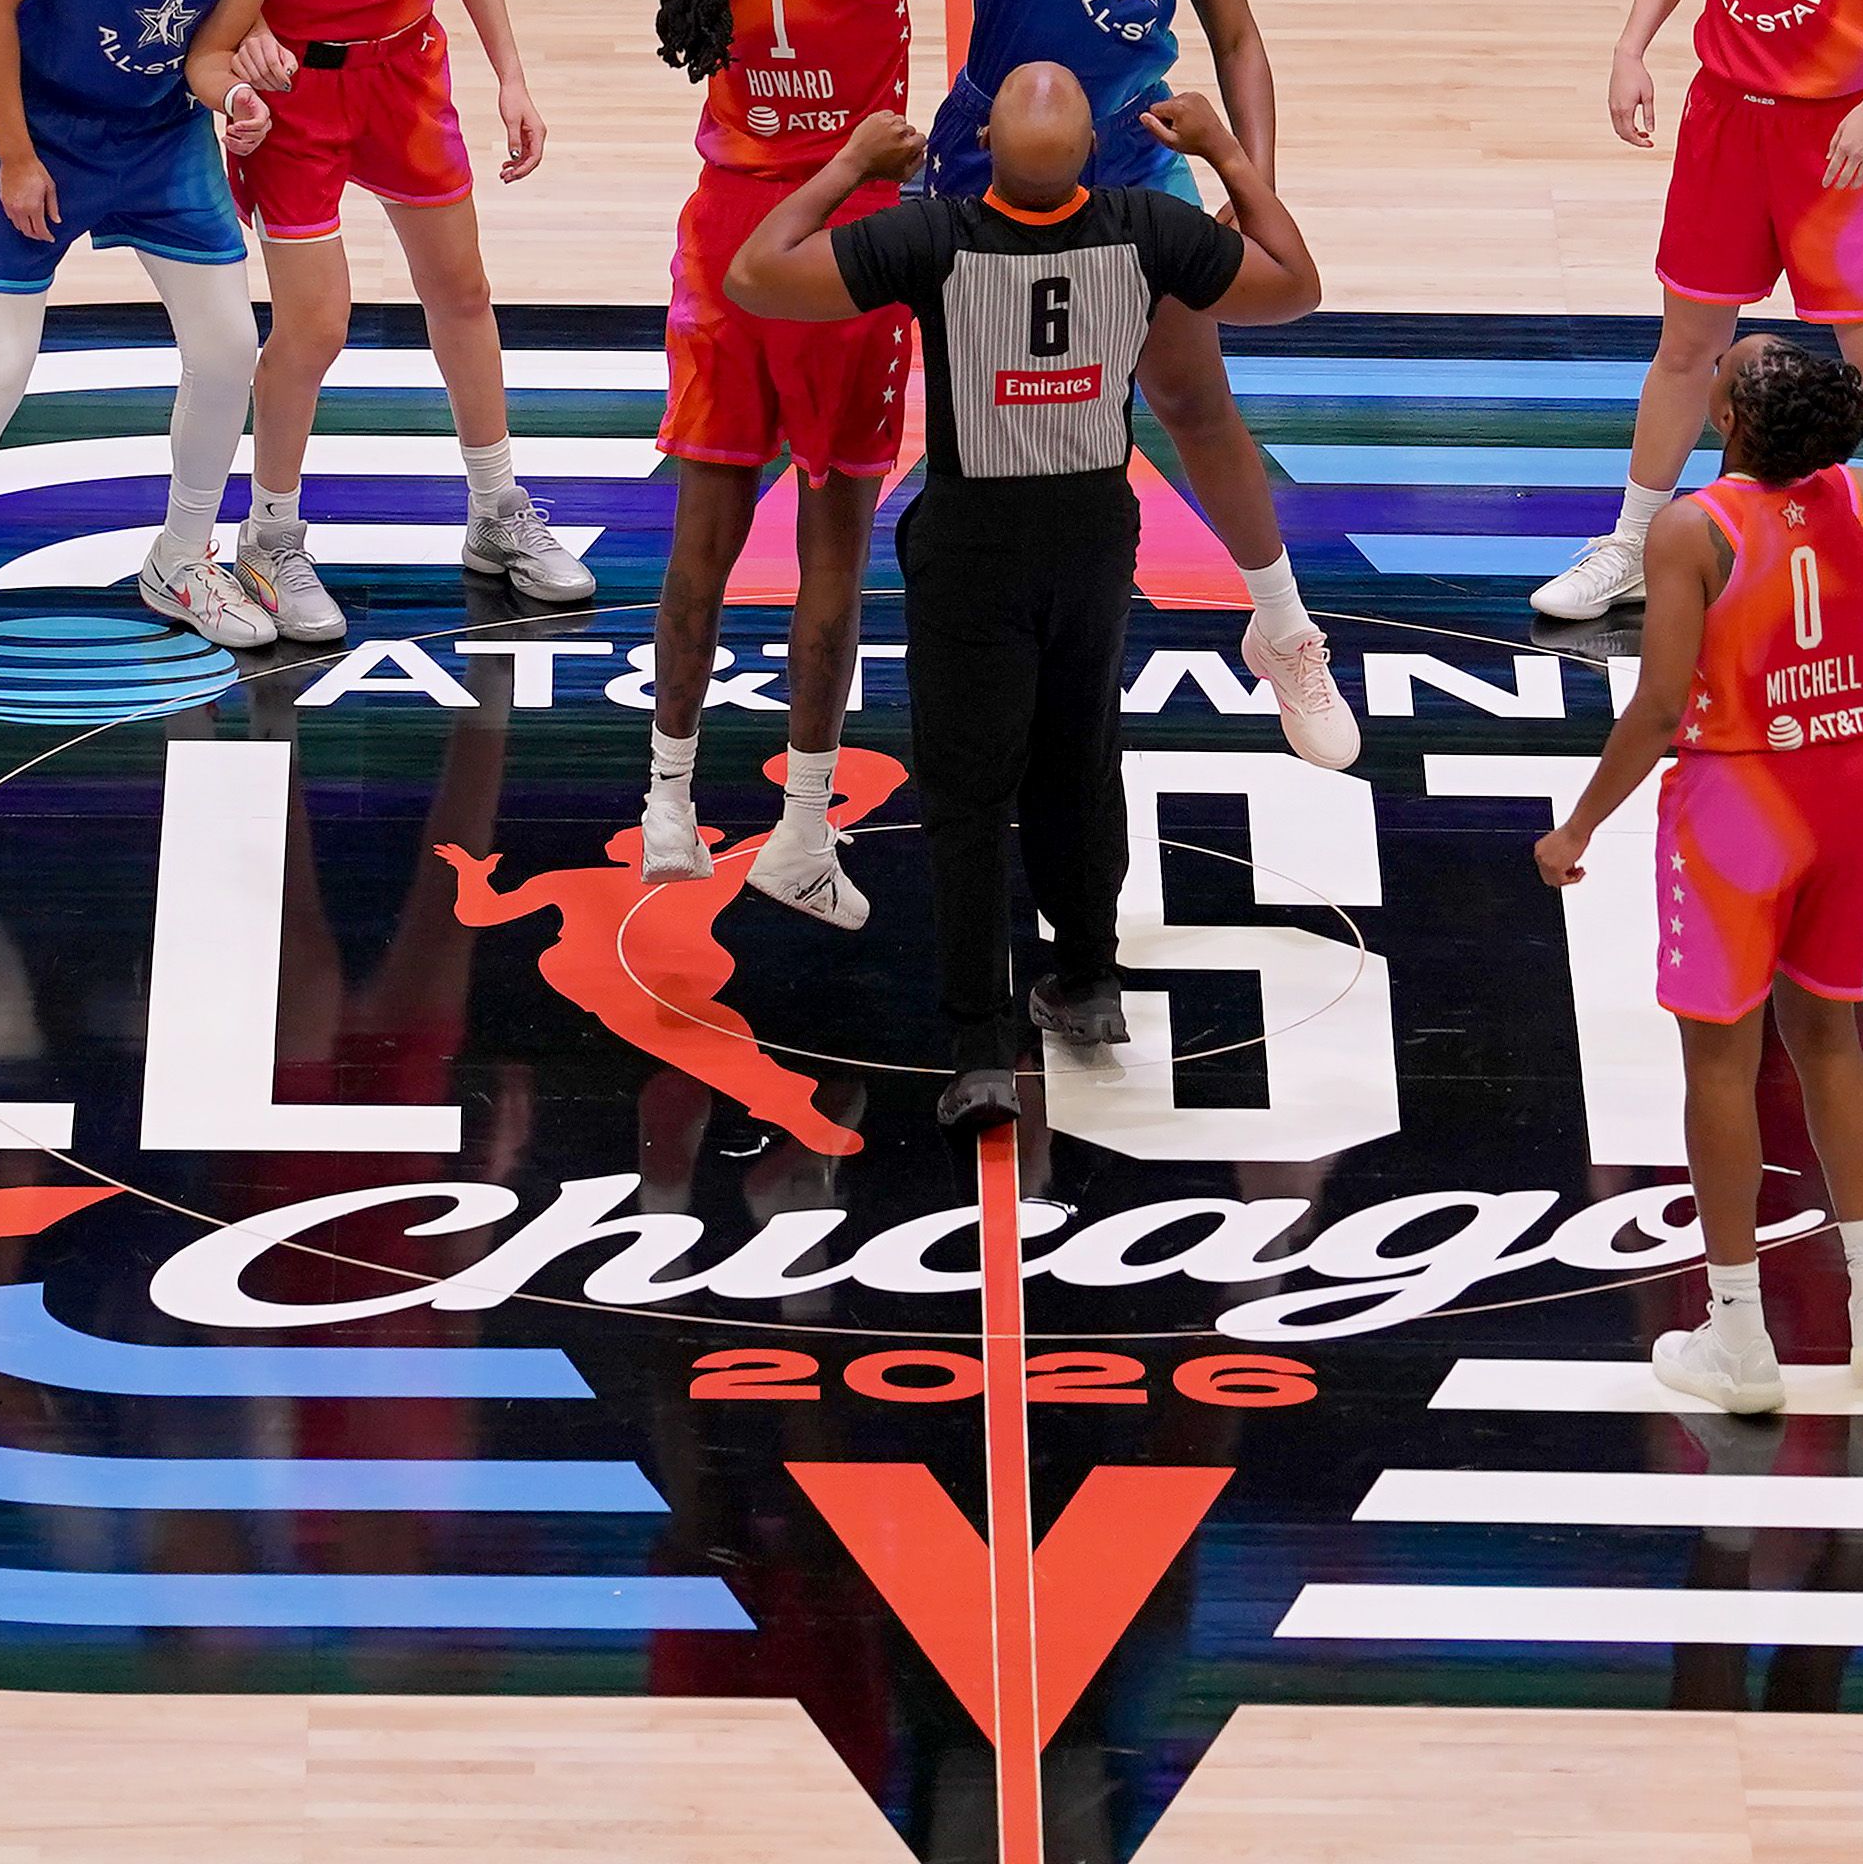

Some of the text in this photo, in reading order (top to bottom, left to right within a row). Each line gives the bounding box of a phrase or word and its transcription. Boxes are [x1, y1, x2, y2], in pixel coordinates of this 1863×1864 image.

[97, 24, 186, 76] ALL-ST
[745, 67, 835, 100] HOWARD
[786, 108, 850, 132] AT&T
[1029, 276, 1071, 358] 6
[1005, 376, 1092, 397] Emirates
[1790, 544, 1823, 650] 0
[1765, 654, 1862, 709] MITCHELL
[151, 1174, 1827, 1342] Chicago
[687, 1347, 1320, 1408] 2026
